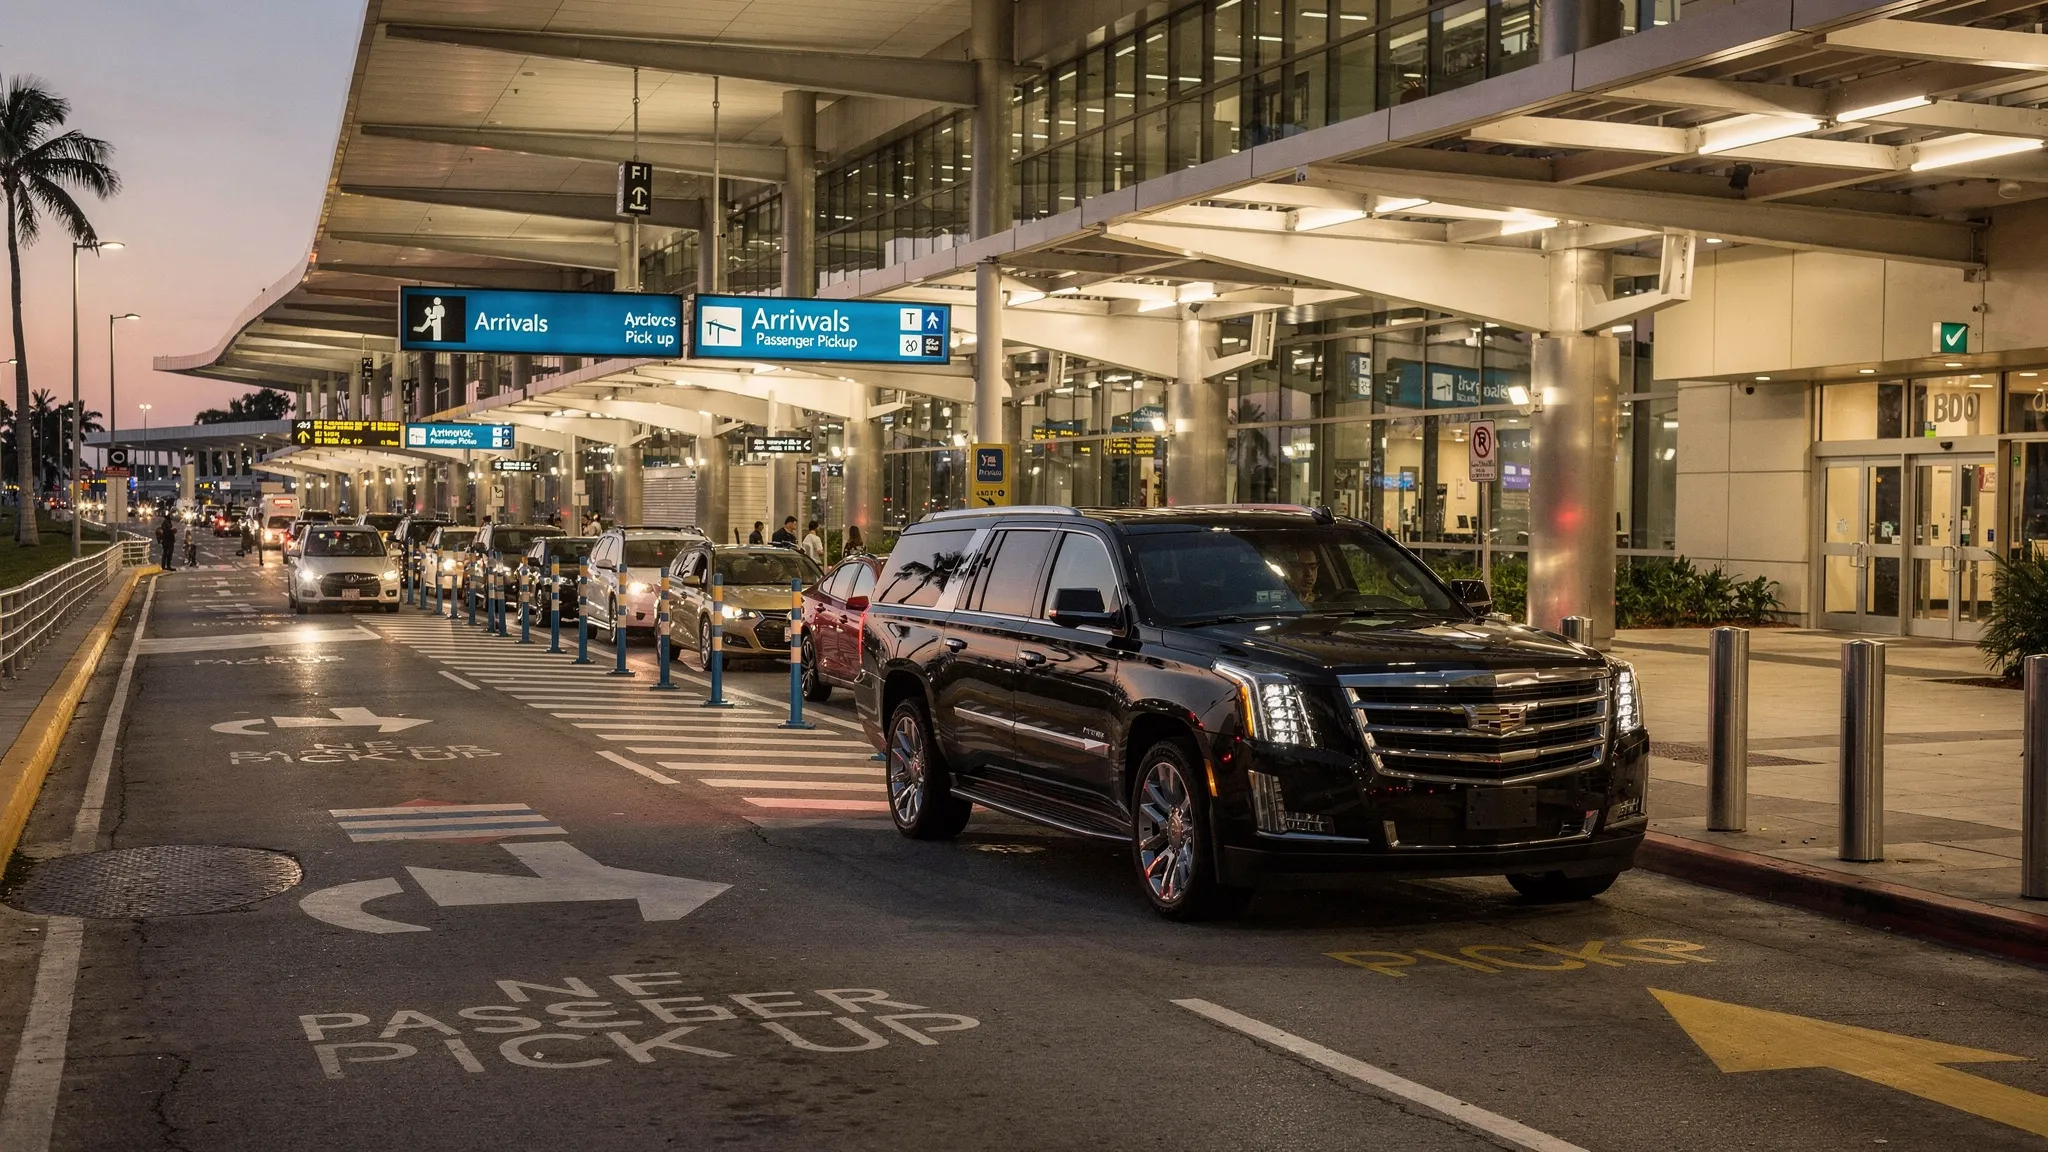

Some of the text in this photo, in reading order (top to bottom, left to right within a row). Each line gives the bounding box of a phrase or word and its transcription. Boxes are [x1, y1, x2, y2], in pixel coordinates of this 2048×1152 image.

[474, 311, 548, 333] Arrivals
[625, 330, 675, 347] Pick up
[756, 332, 858, 352] Passenger Pickup
[313, 1013, 981, 1079] PICK UP
